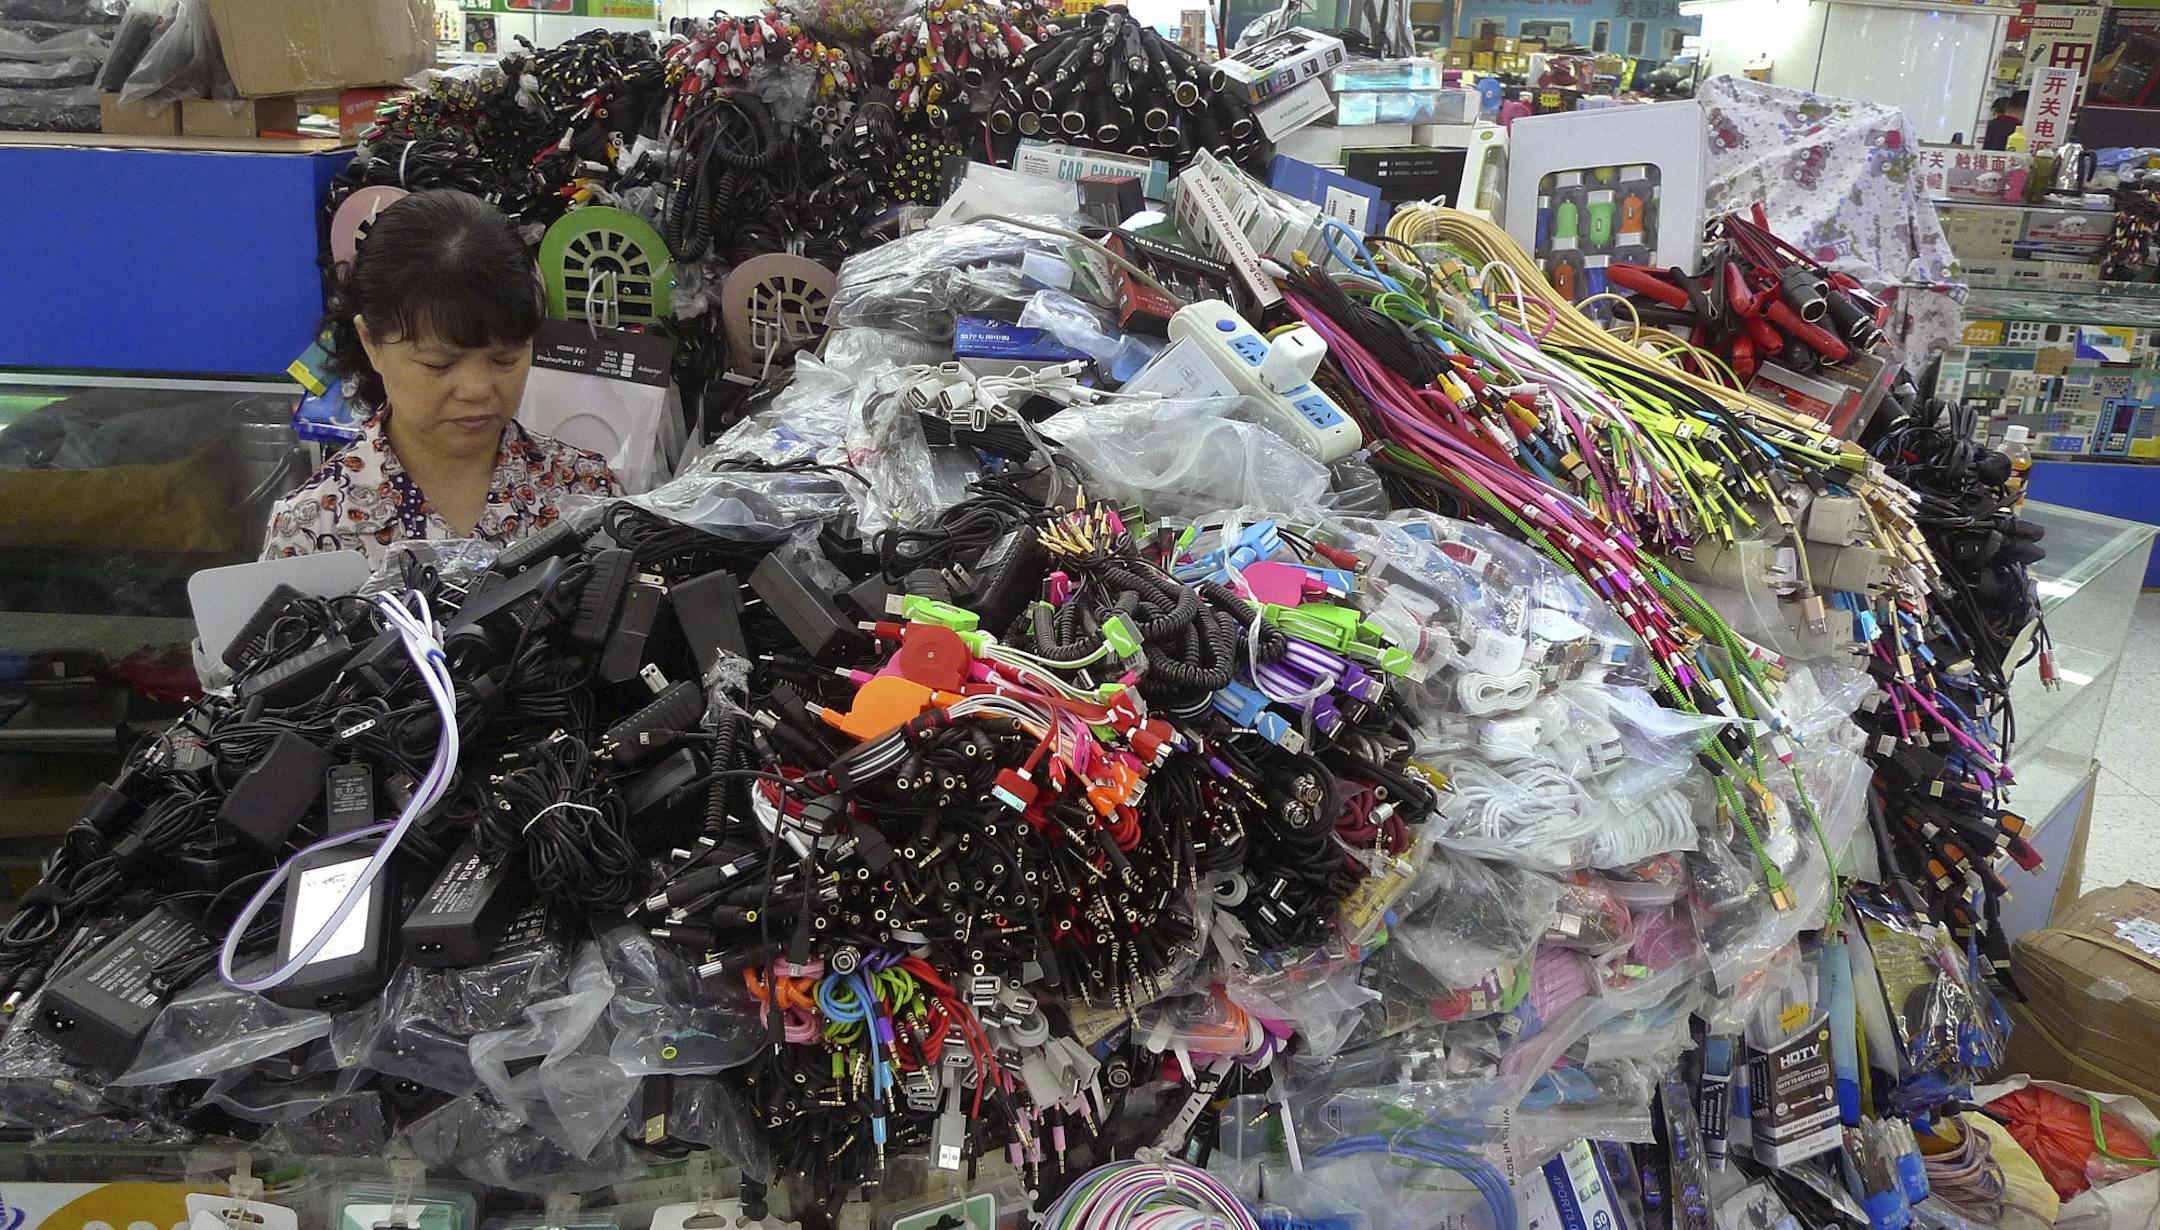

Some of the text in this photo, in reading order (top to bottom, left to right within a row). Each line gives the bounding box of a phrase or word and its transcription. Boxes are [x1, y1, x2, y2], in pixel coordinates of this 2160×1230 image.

[1058, 159, 1082, 180] CAR
[1195, 178, 1269, 292] Smart Display Super Charging Cable
[1169, 249, 1197, 262] Phone
[1197, 258, 1226, 271] Mobile
[1967, 327, 1996, 341] 2221
[1780, 1043, 1820, 1069] HDTV
[1502, 1108, 1516, 1186] MADE IN CHINA
